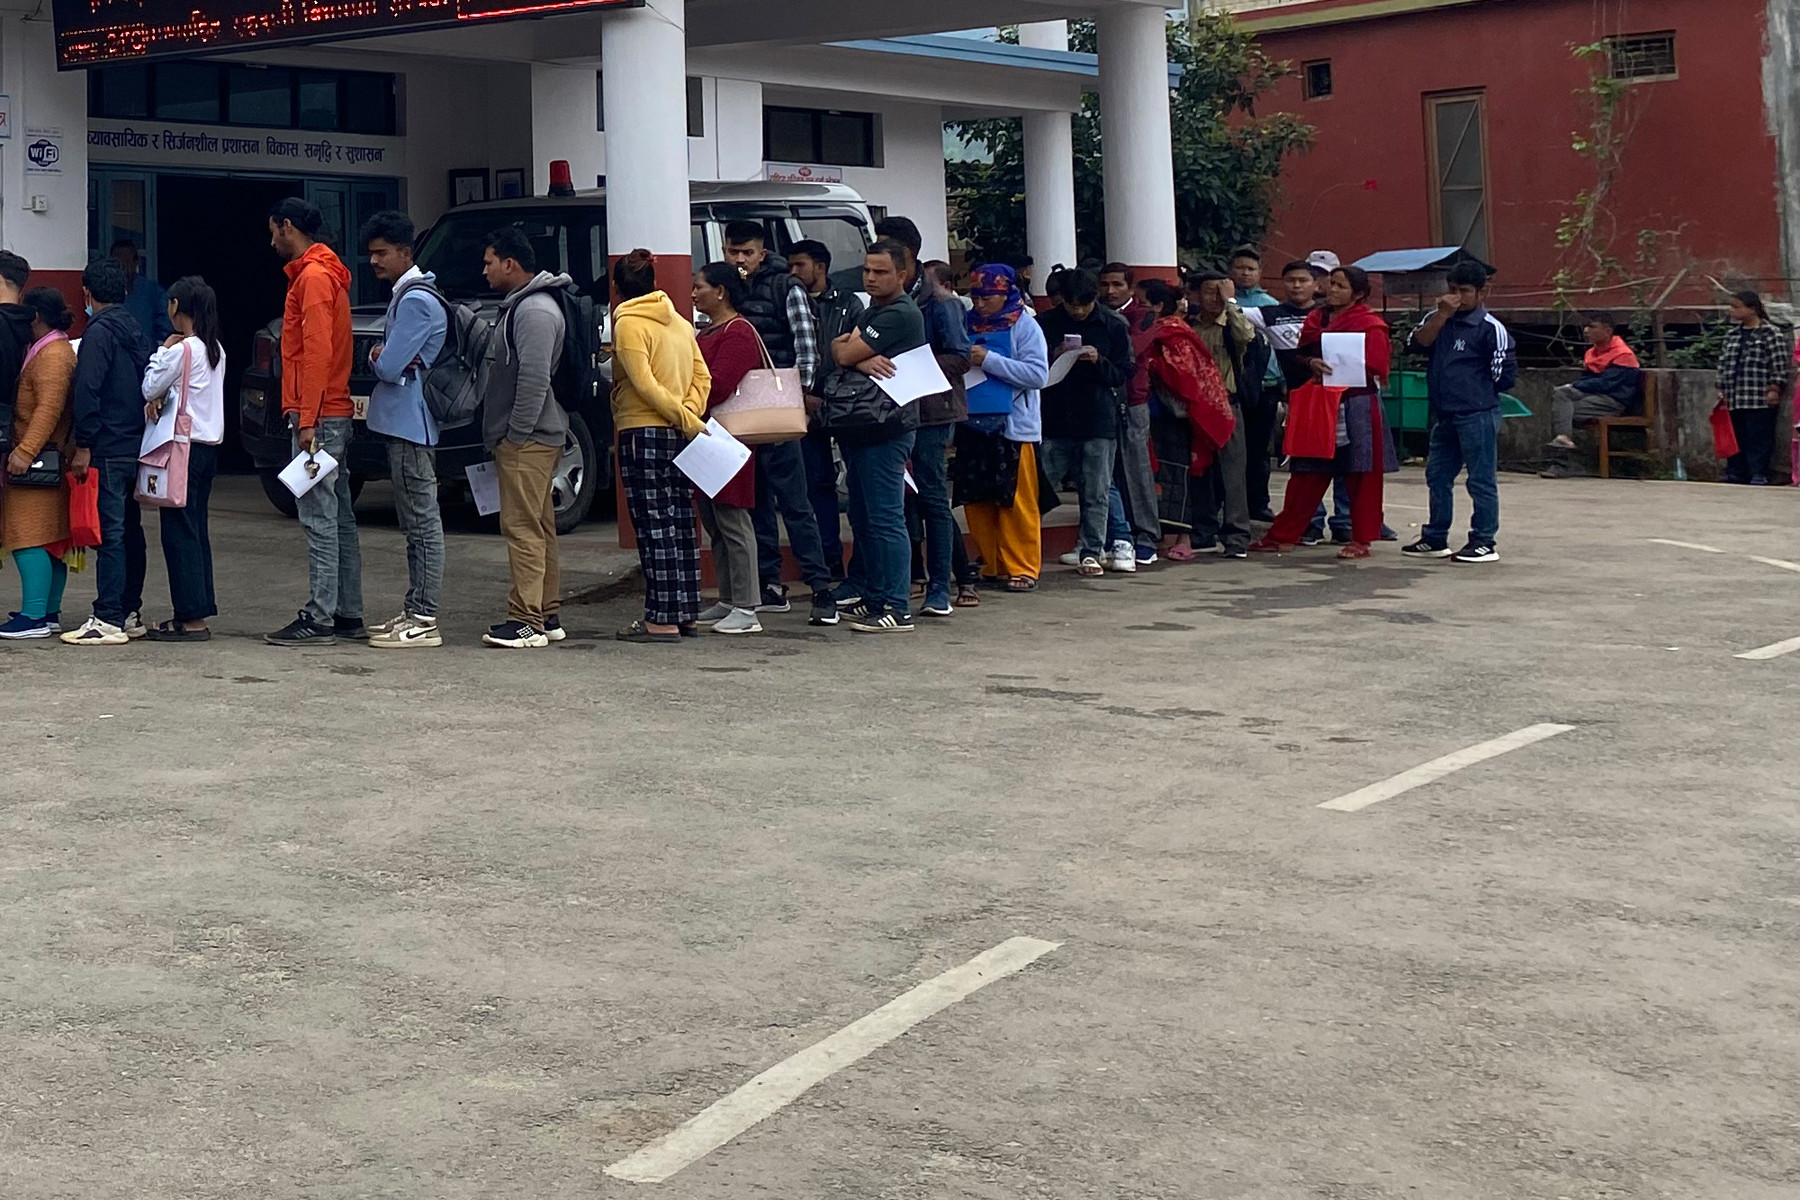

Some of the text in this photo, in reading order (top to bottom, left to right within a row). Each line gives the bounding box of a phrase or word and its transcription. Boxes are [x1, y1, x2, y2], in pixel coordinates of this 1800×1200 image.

[152, 134, 159, 149] र
[163, 130, 218, 152] सिर्जनशील
[222, 138, 259, 154] प्रशासन
[336, 146, 342, 160] र
[346, 146, 385, 164] सुशासन
